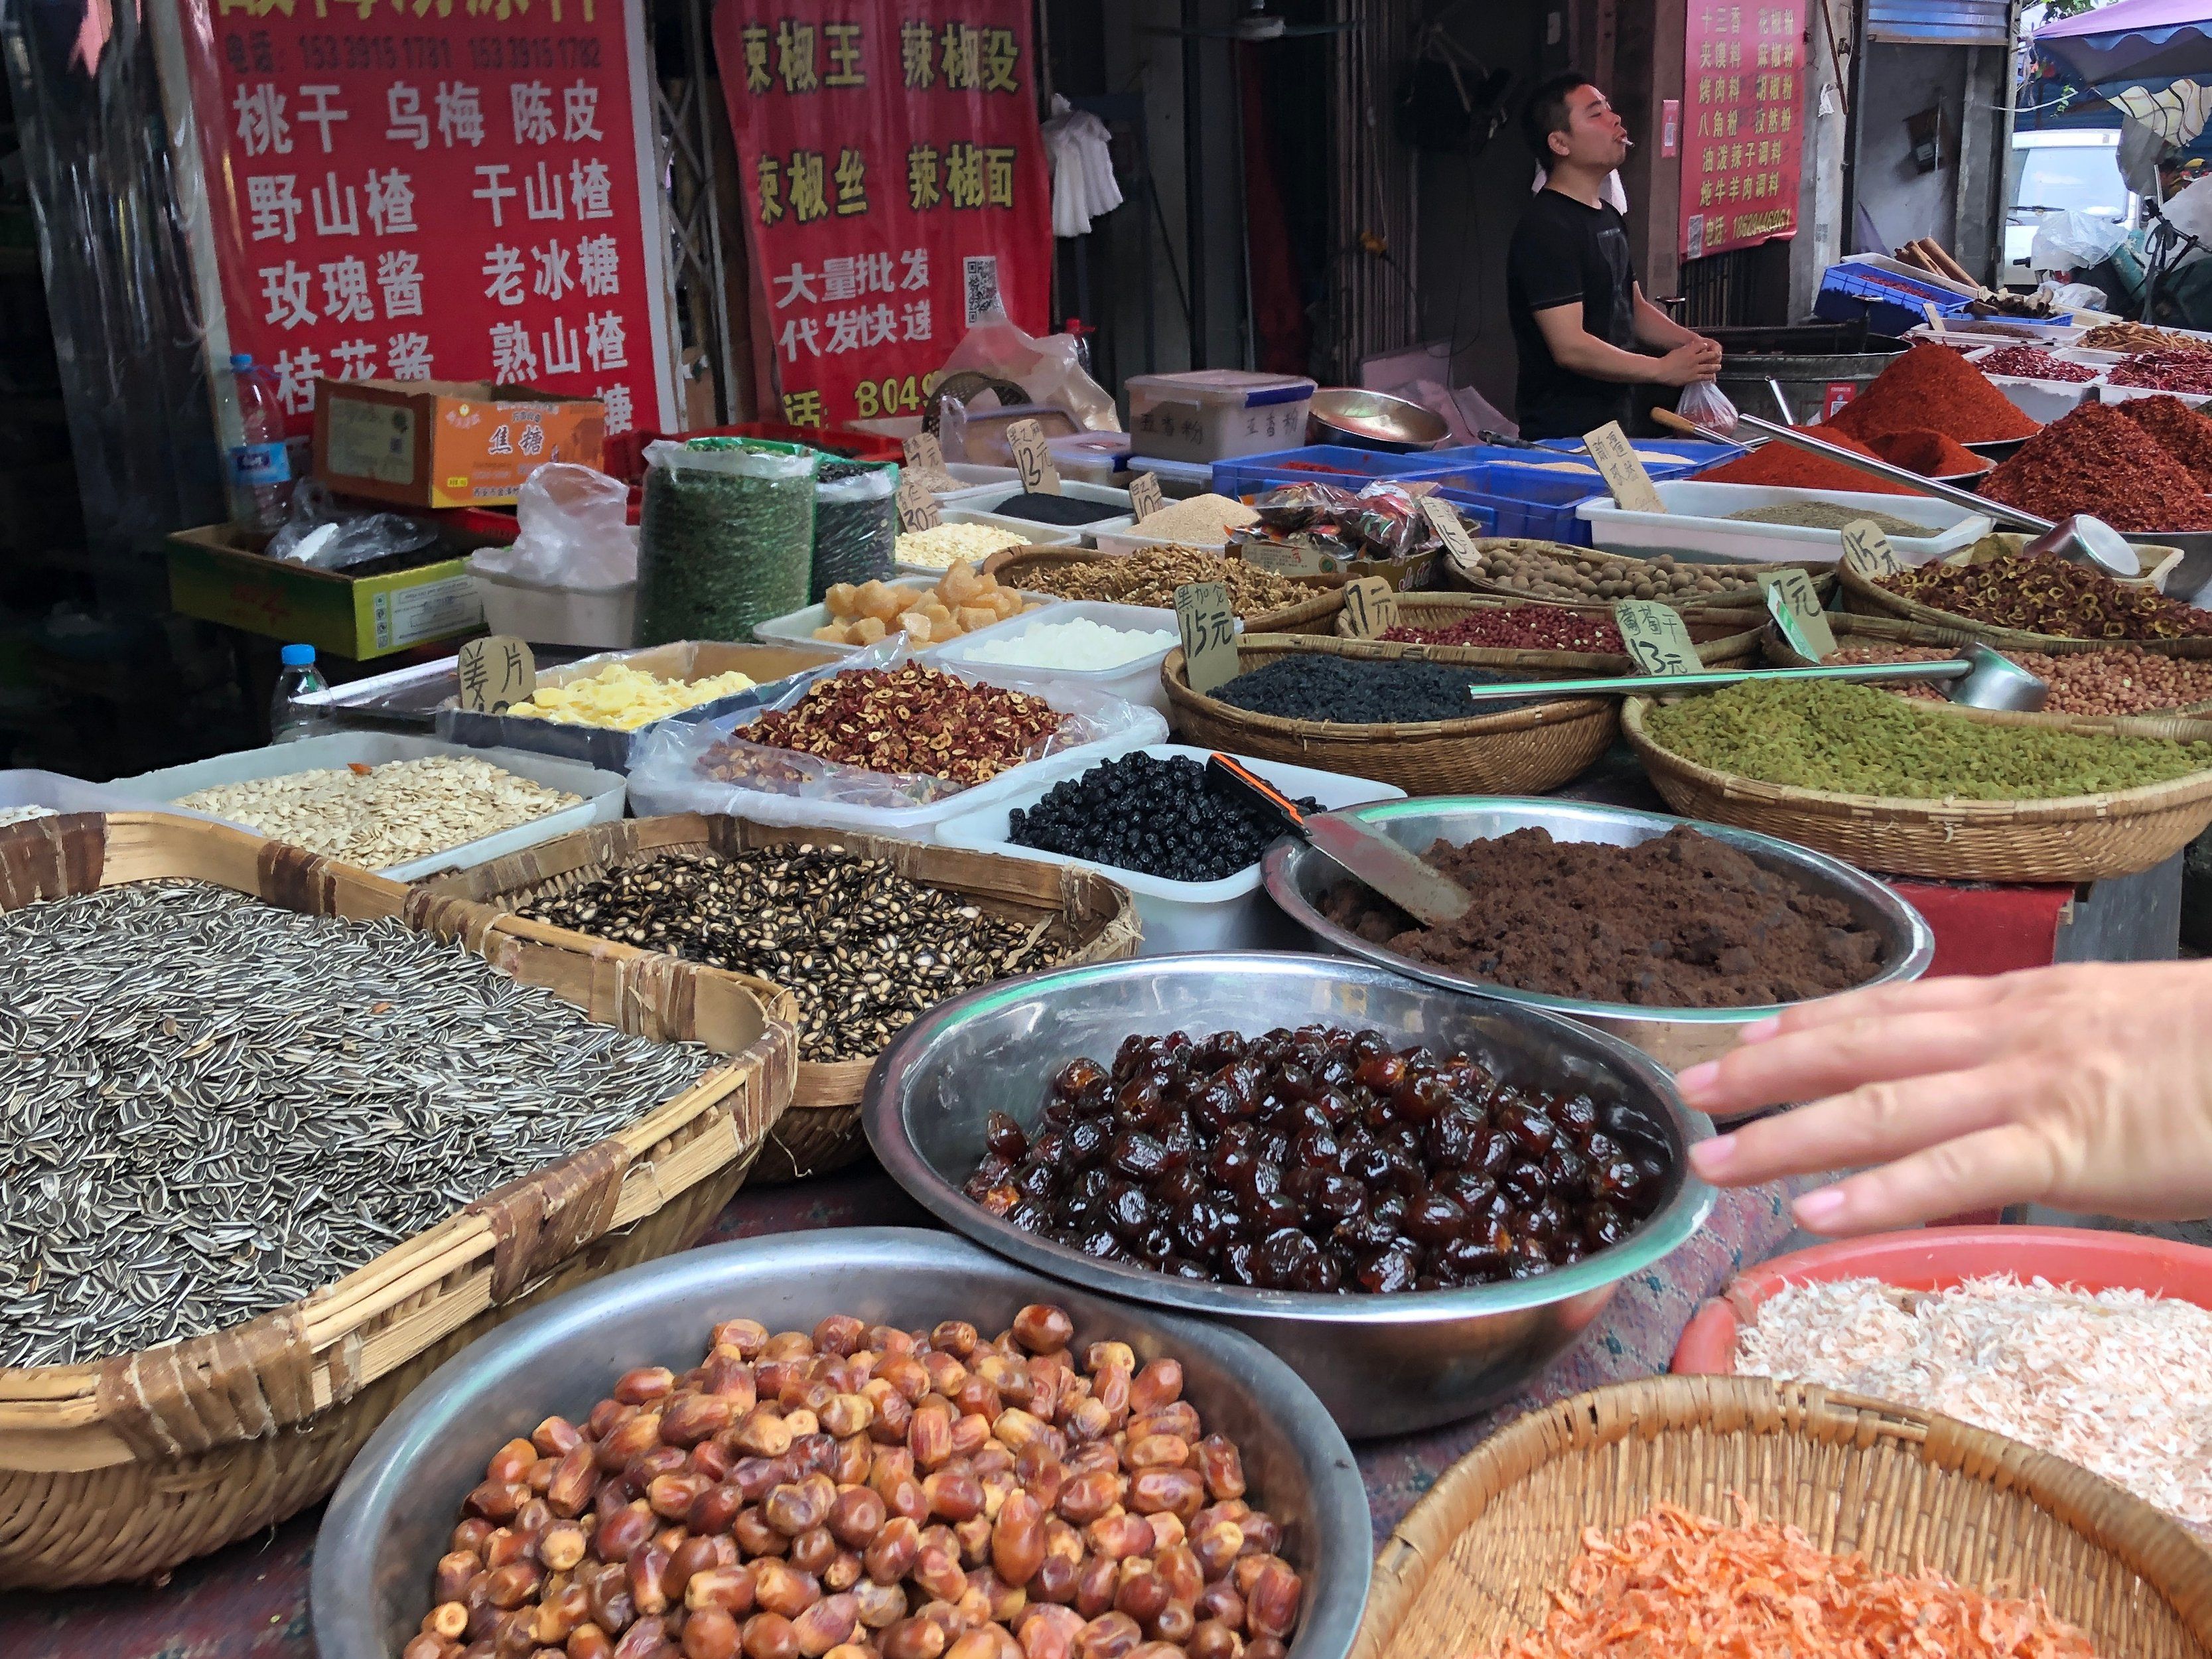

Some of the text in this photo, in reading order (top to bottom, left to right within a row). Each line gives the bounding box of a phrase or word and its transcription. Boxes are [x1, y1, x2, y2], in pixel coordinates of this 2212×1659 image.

[1701, 6, 1740, 34] 十三香
[233, 78, 604, 157] 桃干 乌梅 陈皮
[246, 157, 614, 244] 野山楂 干山楂
[259, 233, 620, 331] 玫瑰酱 老冰糖
[773, 248, 929, 309] 大量批发
[778, 299, 932, 362] 代发快递
[273, 310, 629, 415] 桂花酱 熟山楂
[487, 423, 545, 456] 焦糖
[1184, 608, 1233, 659] 15元
[1629, 637, 1689, 676] 13元
